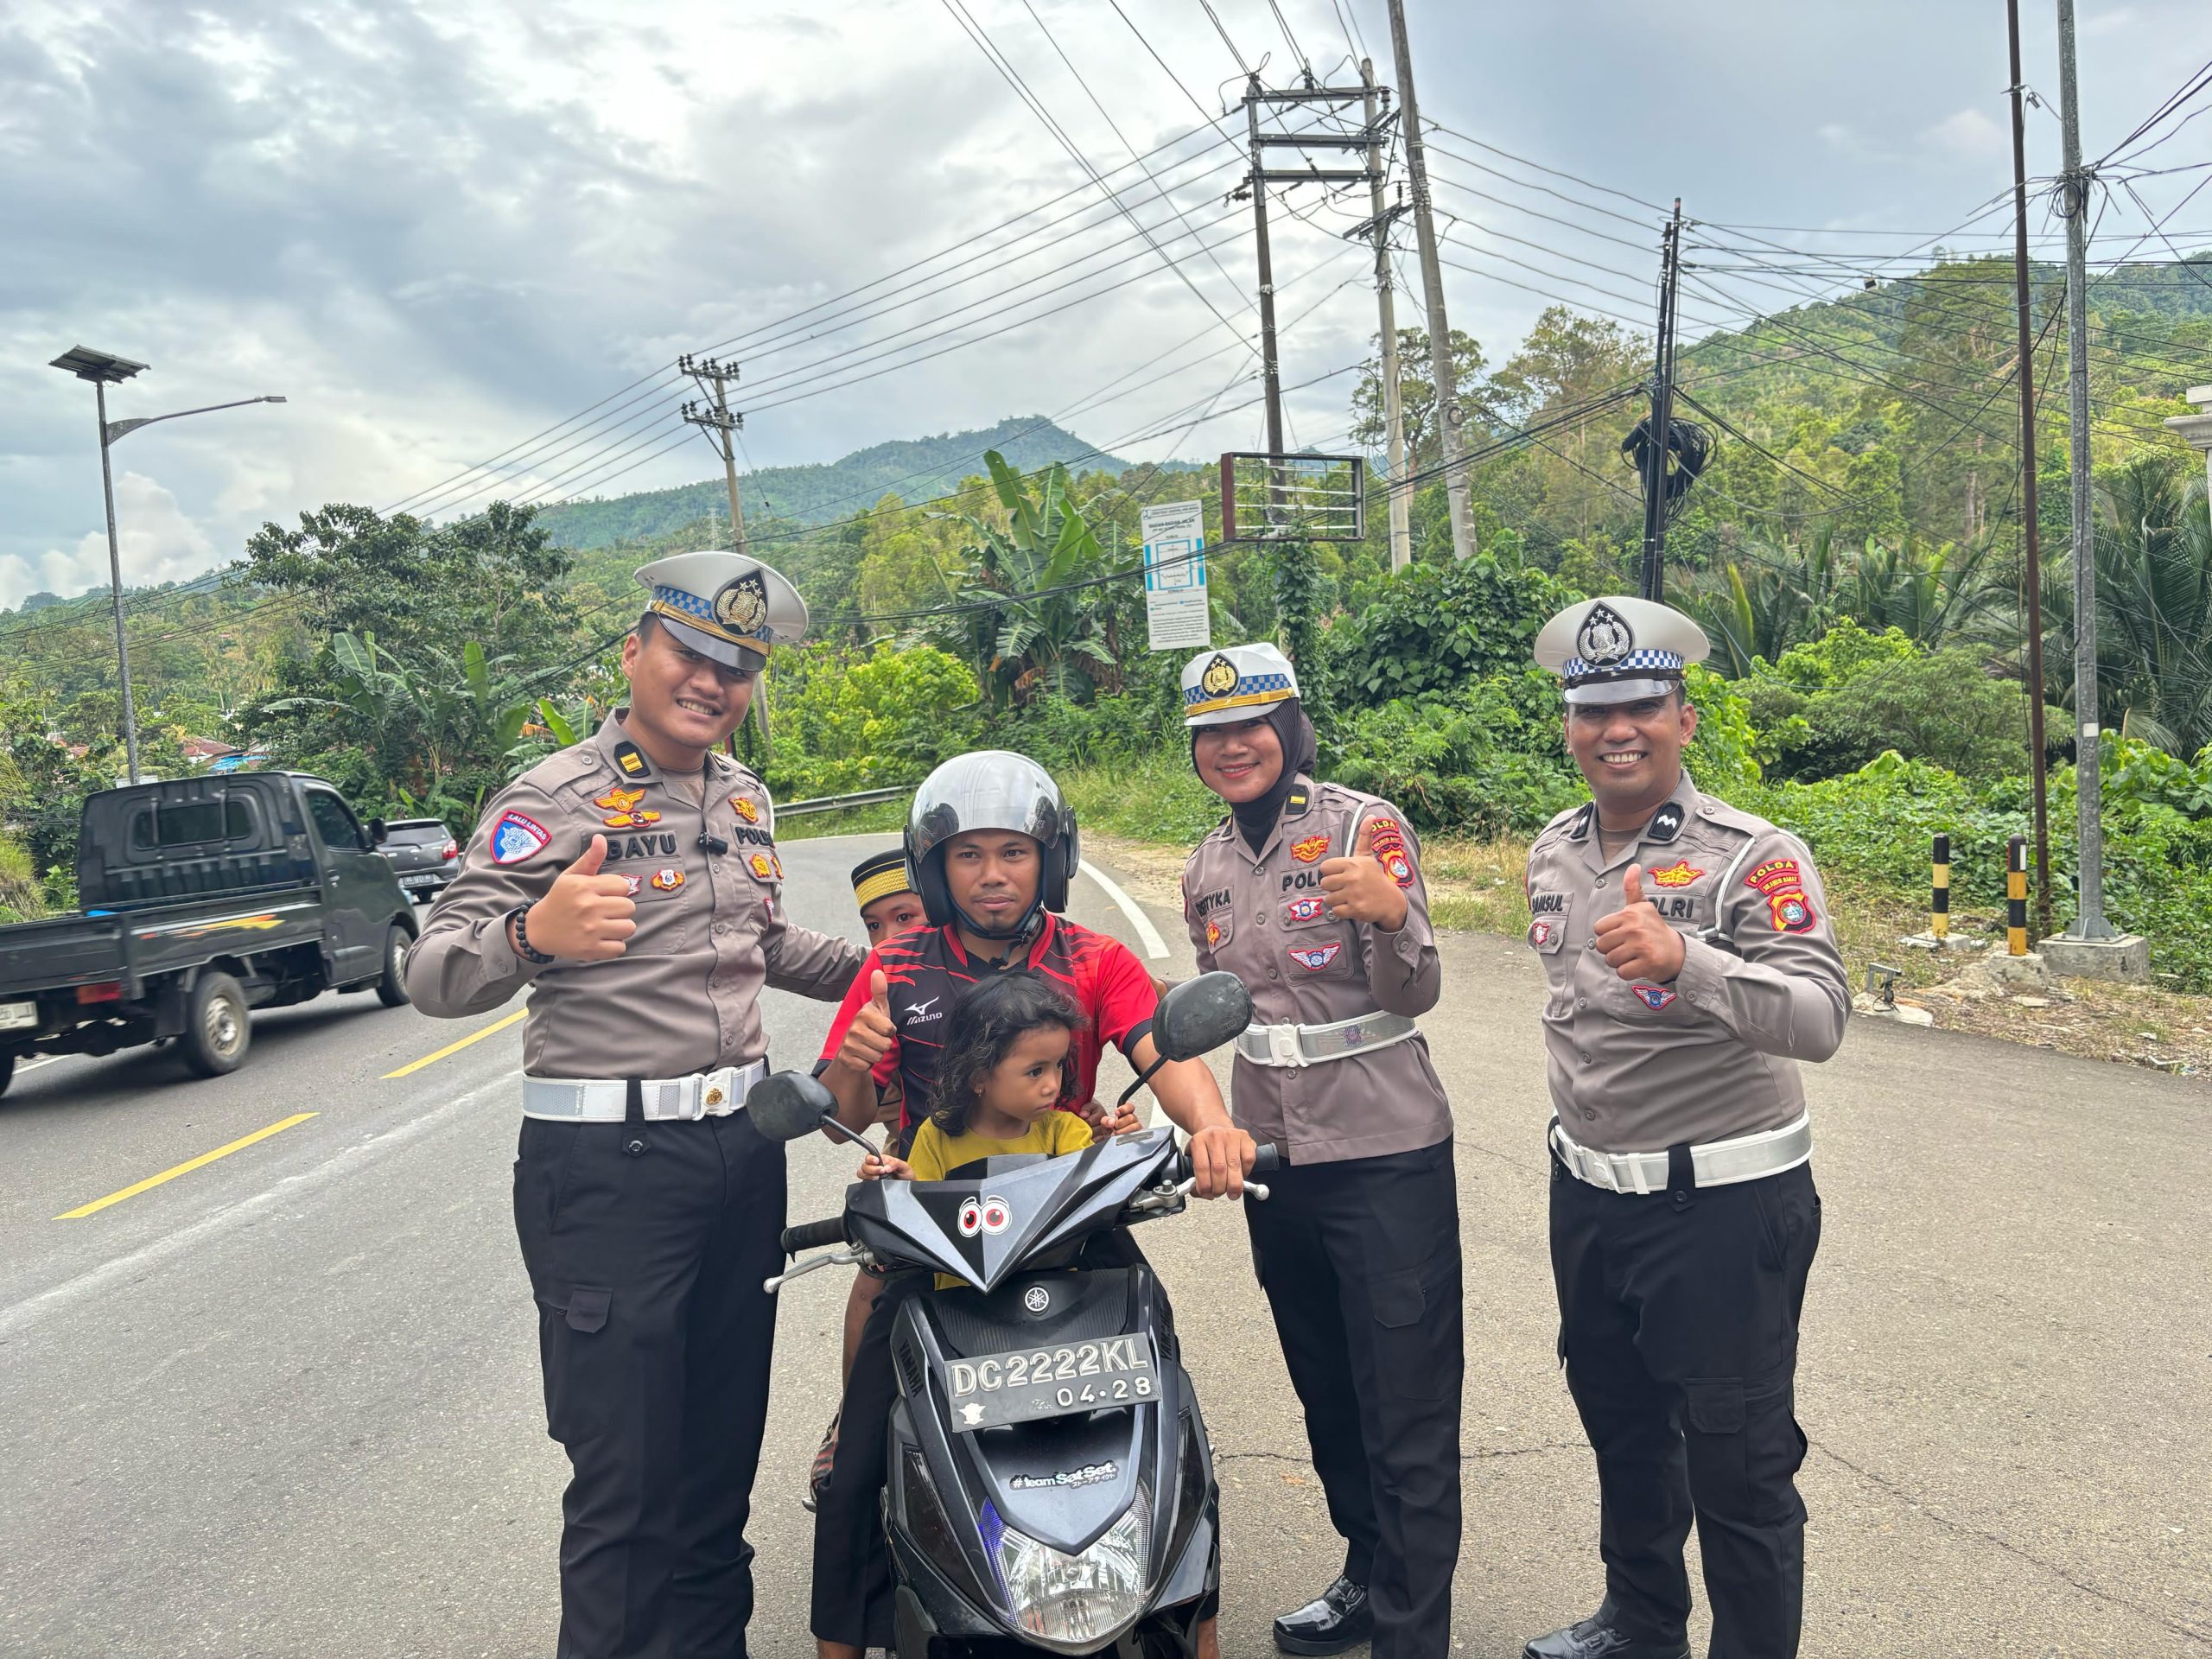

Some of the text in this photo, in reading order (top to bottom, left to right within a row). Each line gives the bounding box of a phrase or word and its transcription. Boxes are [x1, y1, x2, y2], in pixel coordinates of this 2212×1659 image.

[526, 821, 547, 841] LINTAS
[735, 826, 774, 847] POL
[1371, 820, 1396, 832] OLDA
[606, 834, 677, 861] BAYU
[1281, 869, 1324, 892] POL
[1750, 861, 1795, 884] POLDA
[1648, 897, 1694, 919] LRI
[899, 1338, 925, 1398] YAMAHA
